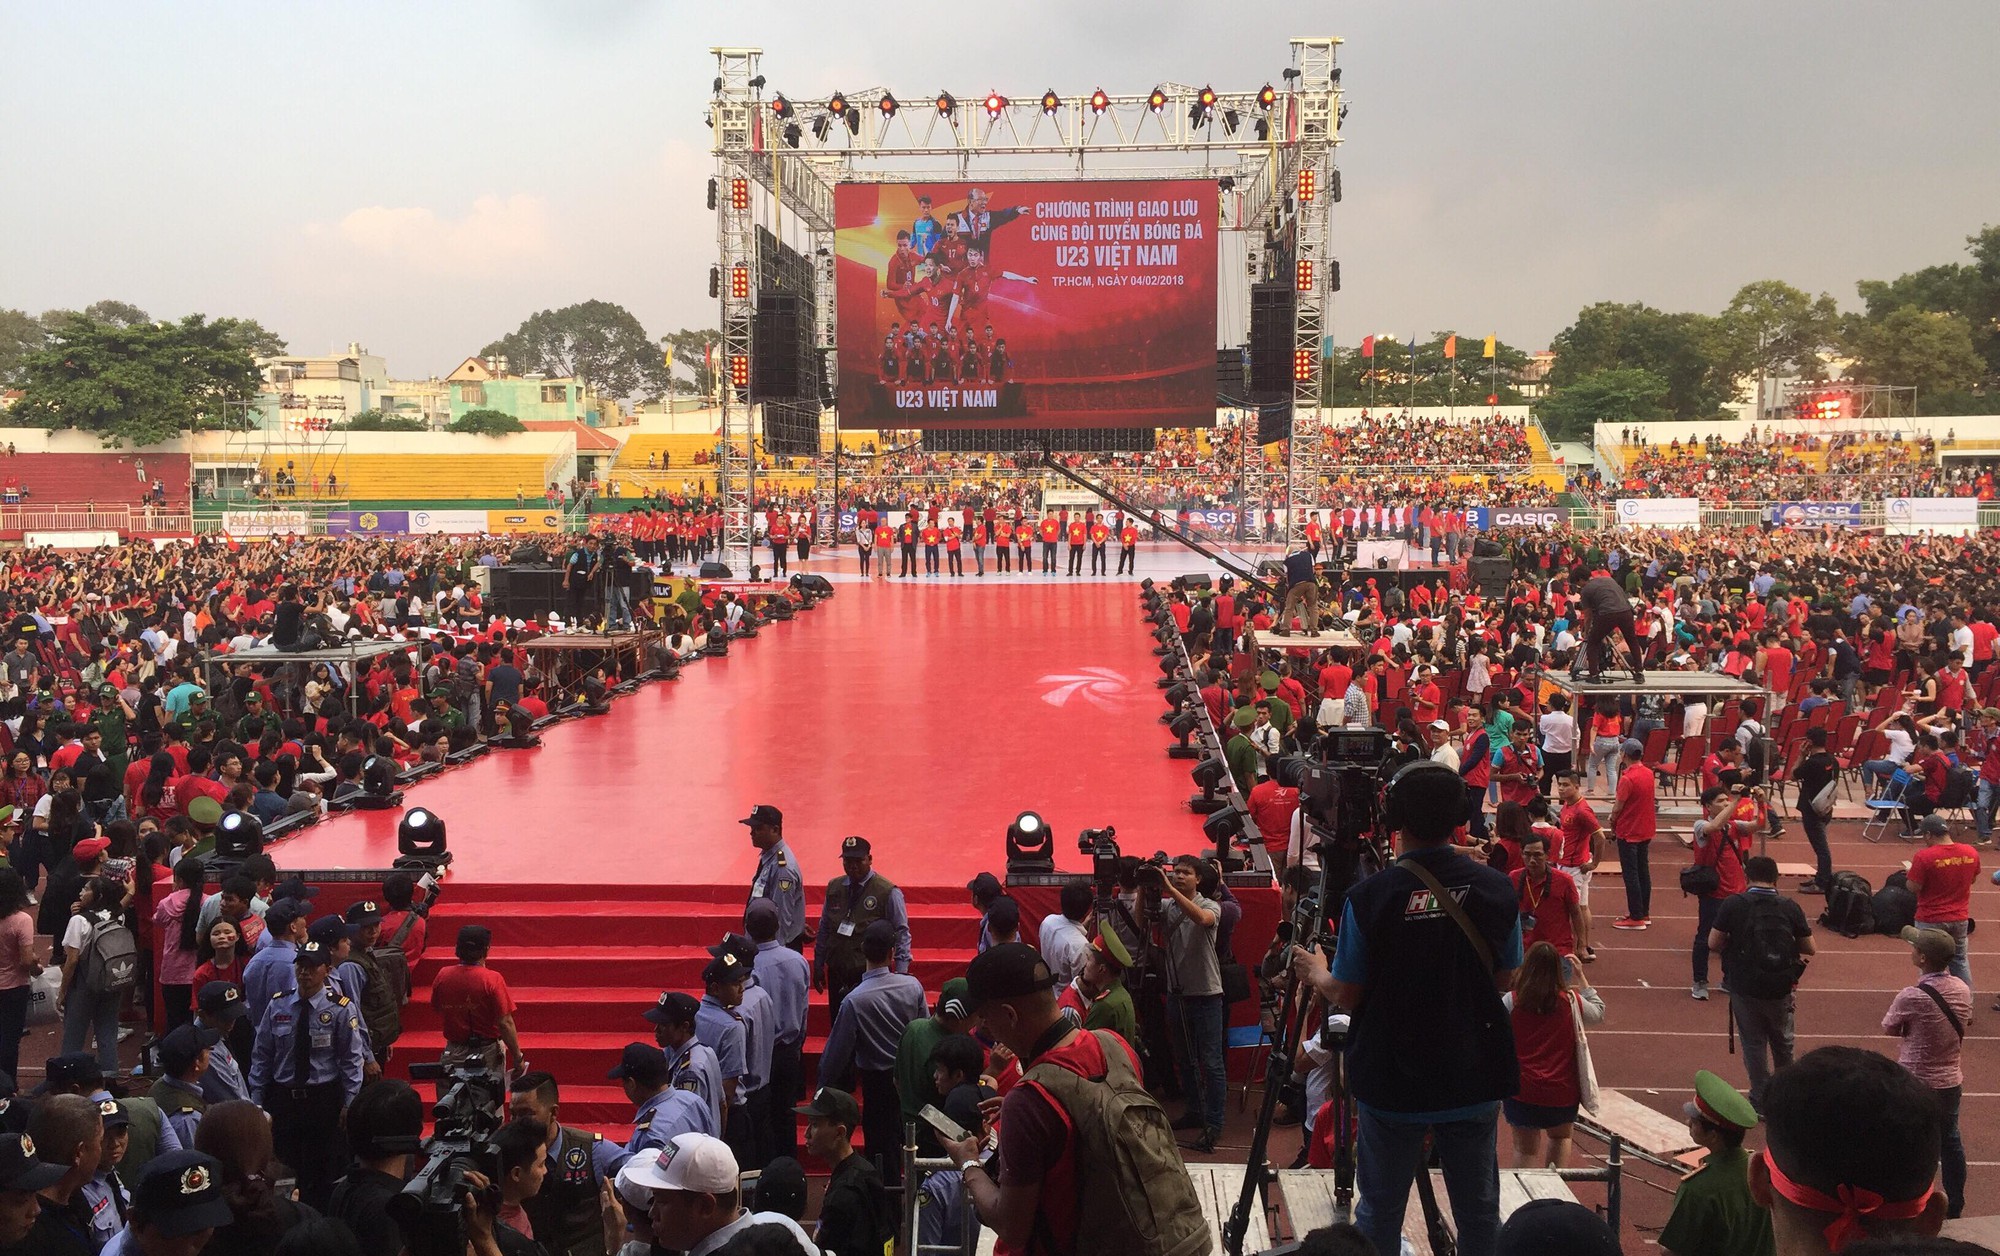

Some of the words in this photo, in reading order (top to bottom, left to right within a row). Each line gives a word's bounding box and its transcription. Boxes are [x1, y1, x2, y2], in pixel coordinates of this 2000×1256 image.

[1035, 200, 1091, 218] CHƯƠNG
[1094, 197, 1134, 218] TRÌNH
[1137, 200, 1169, 217] GIAO
[1172, 198, 1198, 217] LƯU
[1031, 221, 1068, 241] CÙNG
[1071, 221, 1094, 244] ĐỘI
[1097, 217, 1140, 240] TUYỂN
[1144, 220, 1181, 240] BÓNG
[1184, 219, 1203, 239] ĐÁ
[1056, 245, 1089, 267] U23
[1094, 240, 1132, 271] VIỆT
[1136, 244, 1178, 266] NAM
[1052, 276, 1094, 288] TP.HCM,
[1097, 273, 1128, 286] NGÀY
[1130, 275, 1184, 286] 04/02/2018
[895, 390, 923, 408] U23
[927, 386, 959, 411] VIỆT
[962, 389, 997, 408] NAM
[1495, 513, 1558, 527] CASIO
[111, 976, 133, 987] adidas
